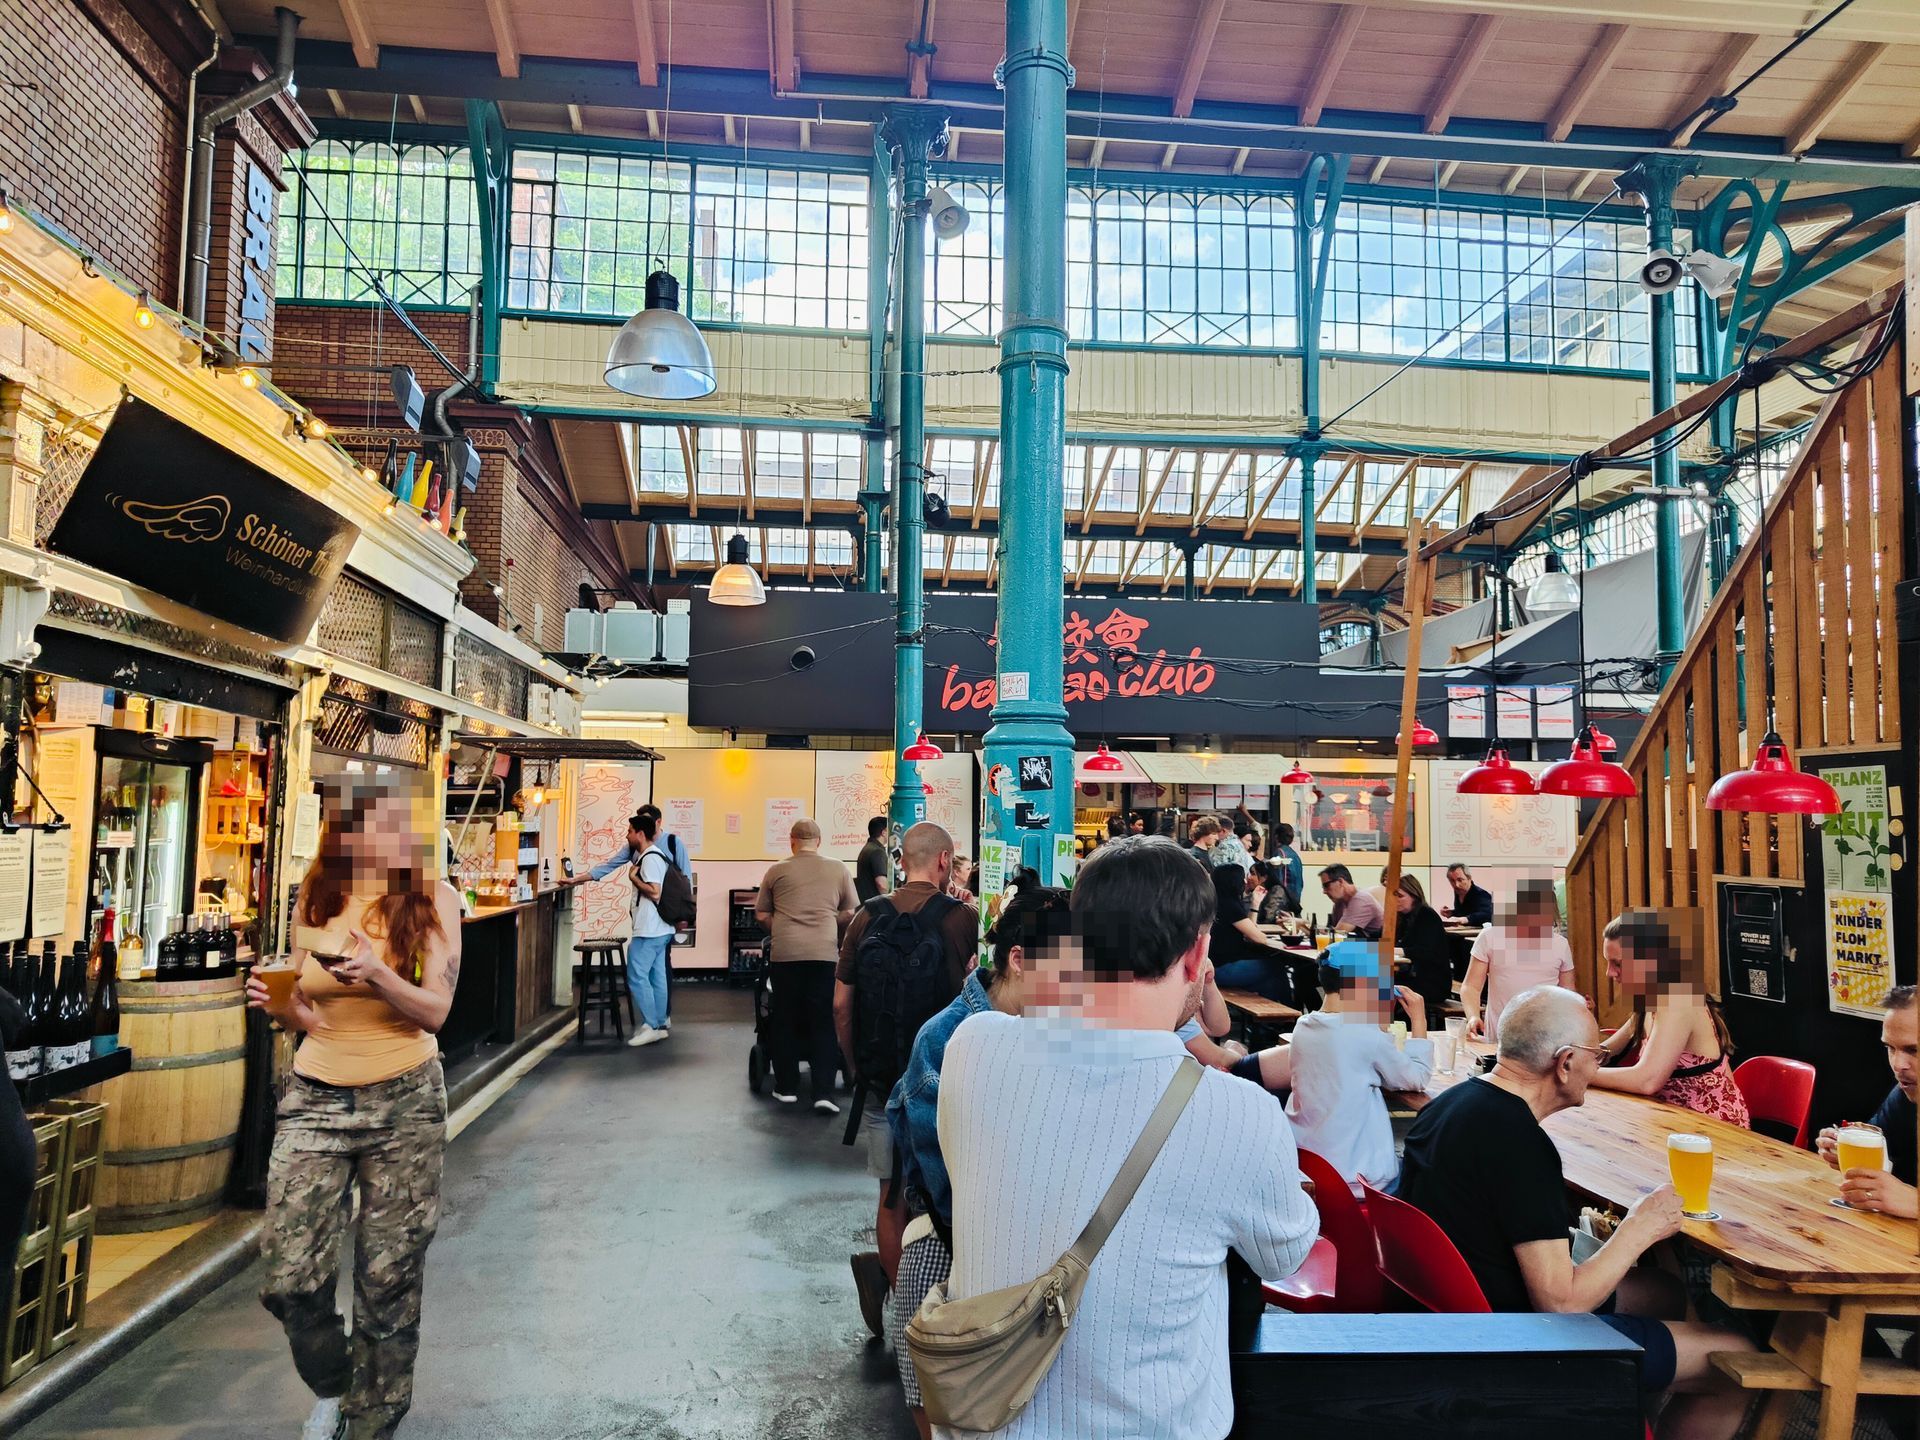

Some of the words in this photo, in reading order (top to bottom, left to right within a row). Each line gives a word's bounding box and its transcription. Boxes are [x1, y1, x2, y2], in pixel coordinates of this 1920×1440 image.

[235, 513, 313, 569] Schöner
[941, 664, 998, 712] ba
[1063, 669, 1110, 702] ao
[1823, 810, 1884, 837] ZEIT
[982, 846, 1002, 863] NZ
[1057, 840, 1075, 857] PF
[1835, 914, 1883, 930] KINDER
[1835, 931, 1867, 946] FLOH
[1836, 949, 1882, 966] MARKT
